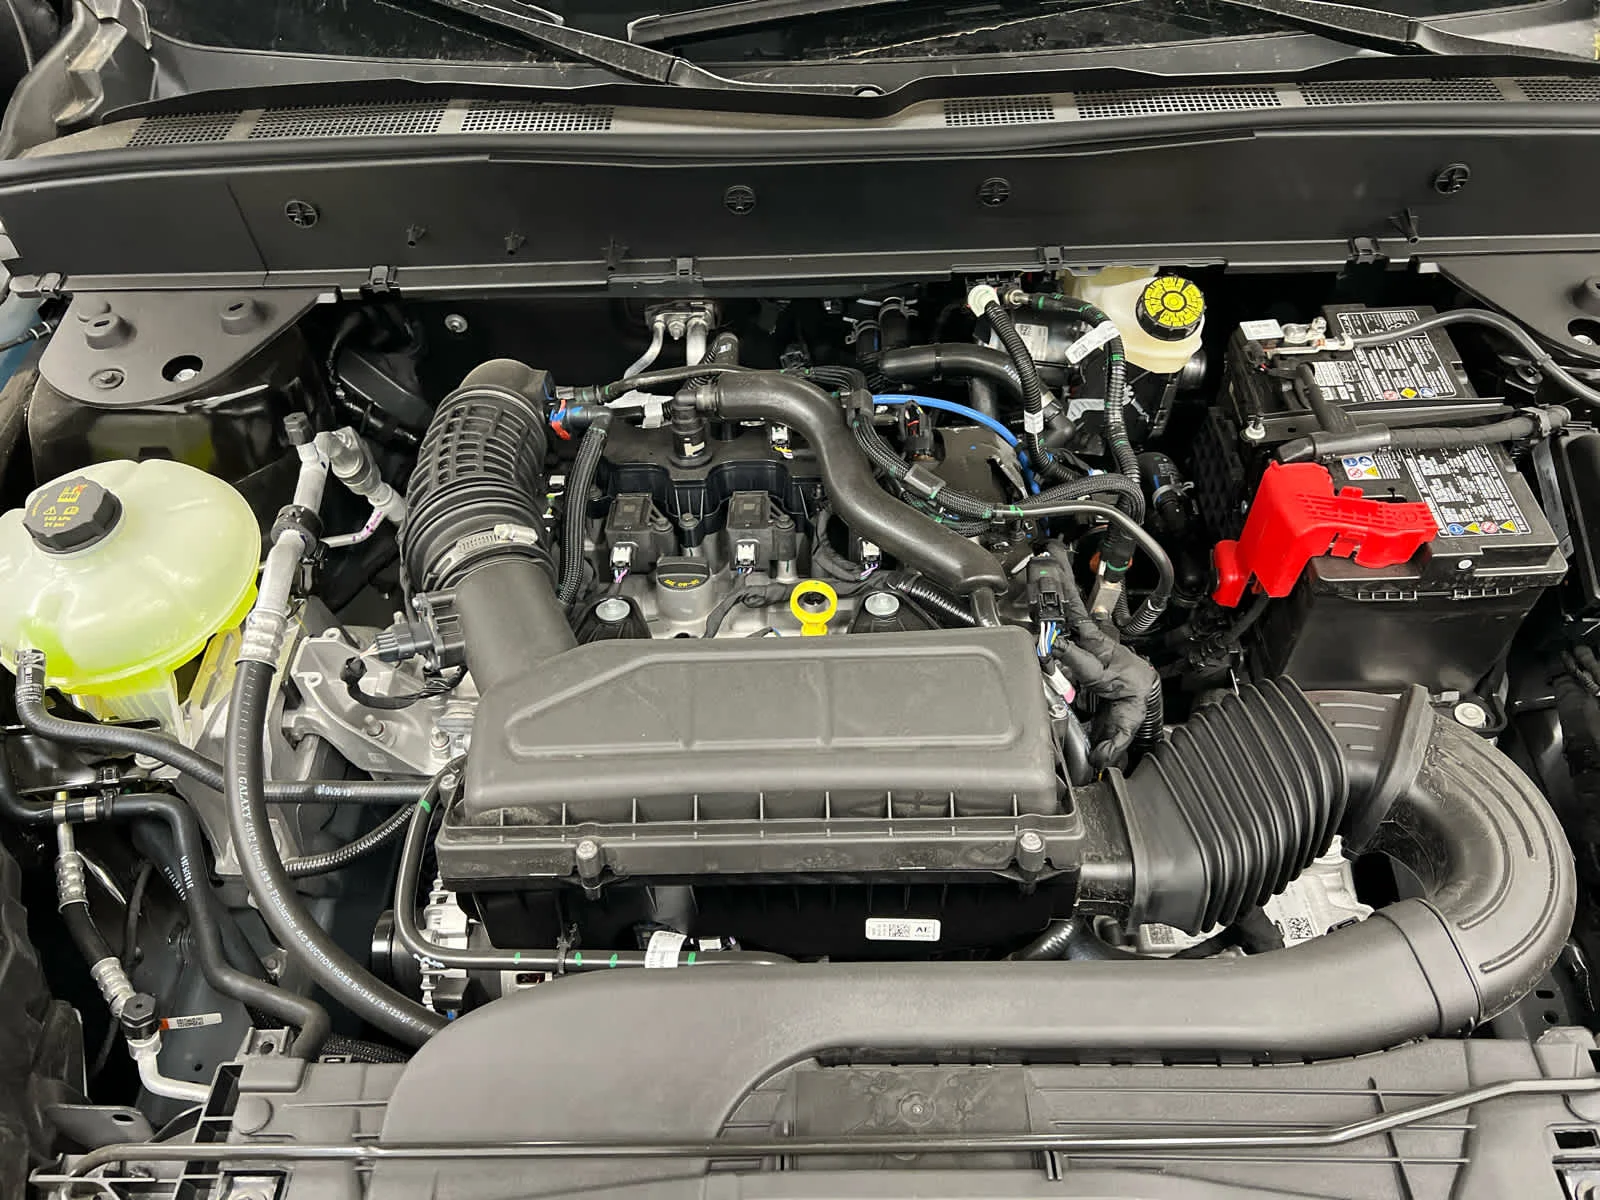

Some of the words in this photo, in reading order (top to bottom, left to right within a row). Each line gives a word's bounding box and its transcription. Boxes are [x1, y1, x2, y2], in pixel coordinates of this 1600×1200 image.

[238, 776, 252, 819] GALAXY
[305, 939, 335, 971] SUCTION
[333, 966, 353, 986] HOSE
